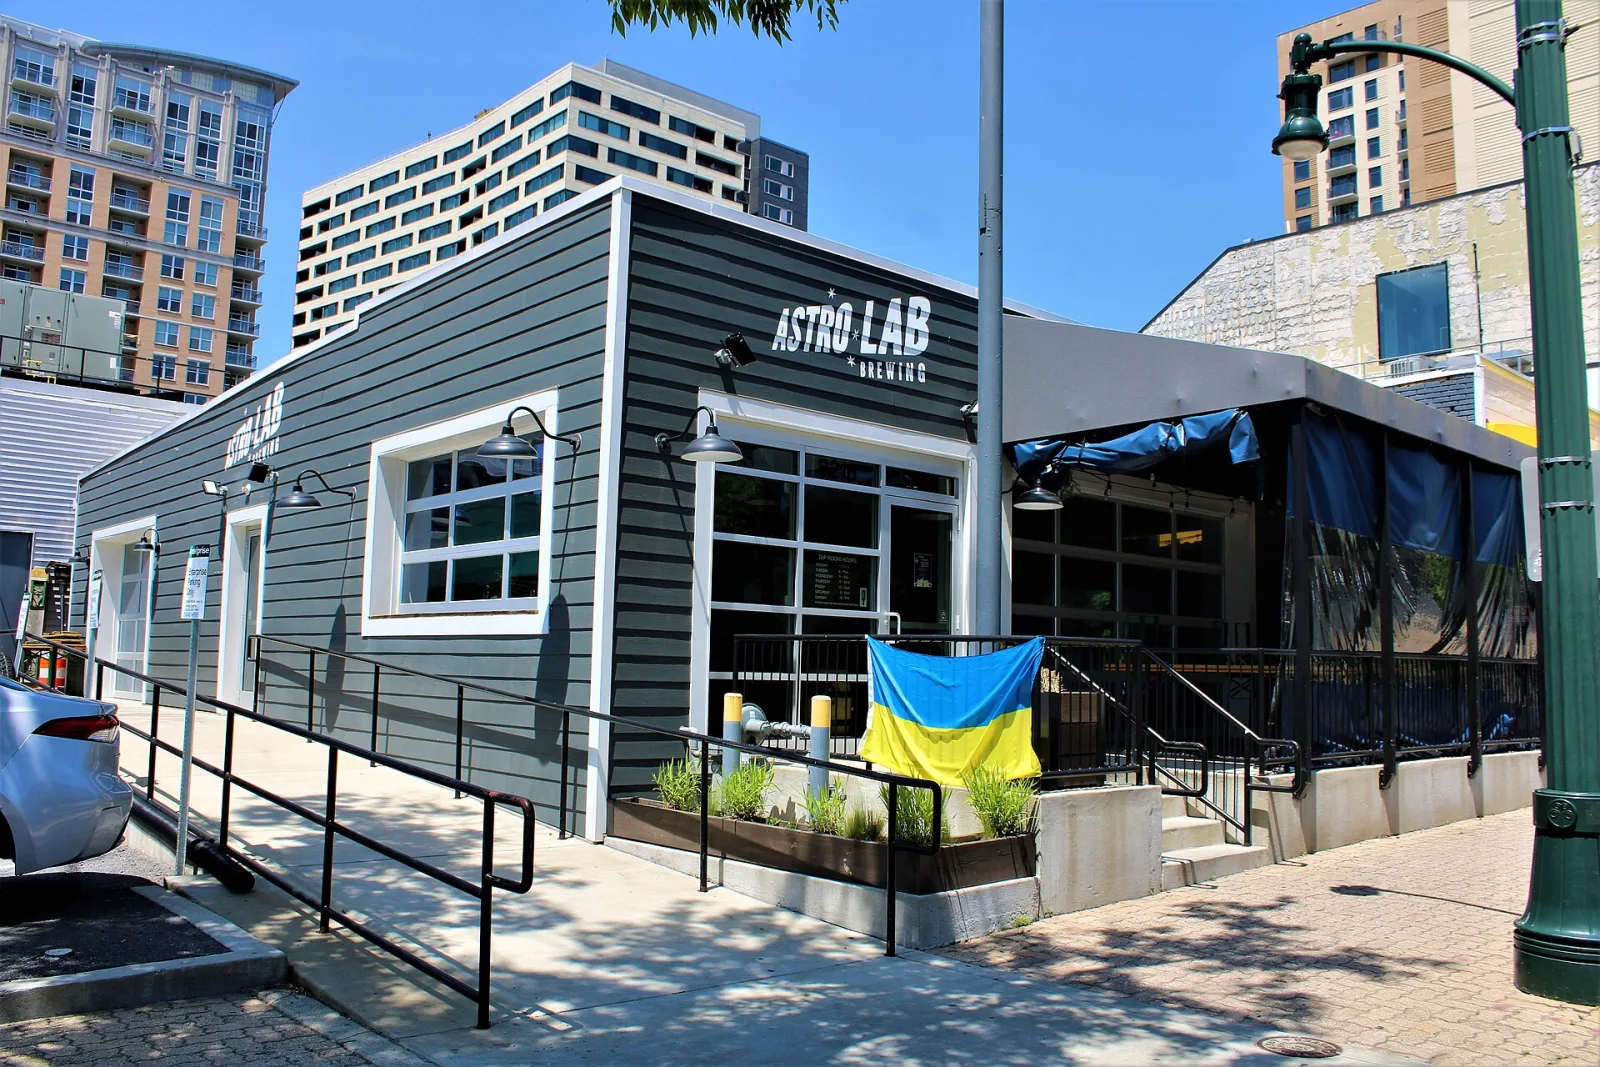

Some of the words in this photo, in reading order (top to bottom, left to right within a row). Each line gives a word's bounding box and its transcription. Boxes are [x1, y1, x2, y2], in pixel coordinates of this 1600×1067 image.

[771, 302, 853, 354] ASTRO
[860, 295, 931, 356] LAB
[859, 361, 927, 383] BREWING
[224, 416, 254, 470] ASTRO
[253, 381, 285, 449] LAB
[252, 436, 280, 464] BREWING
